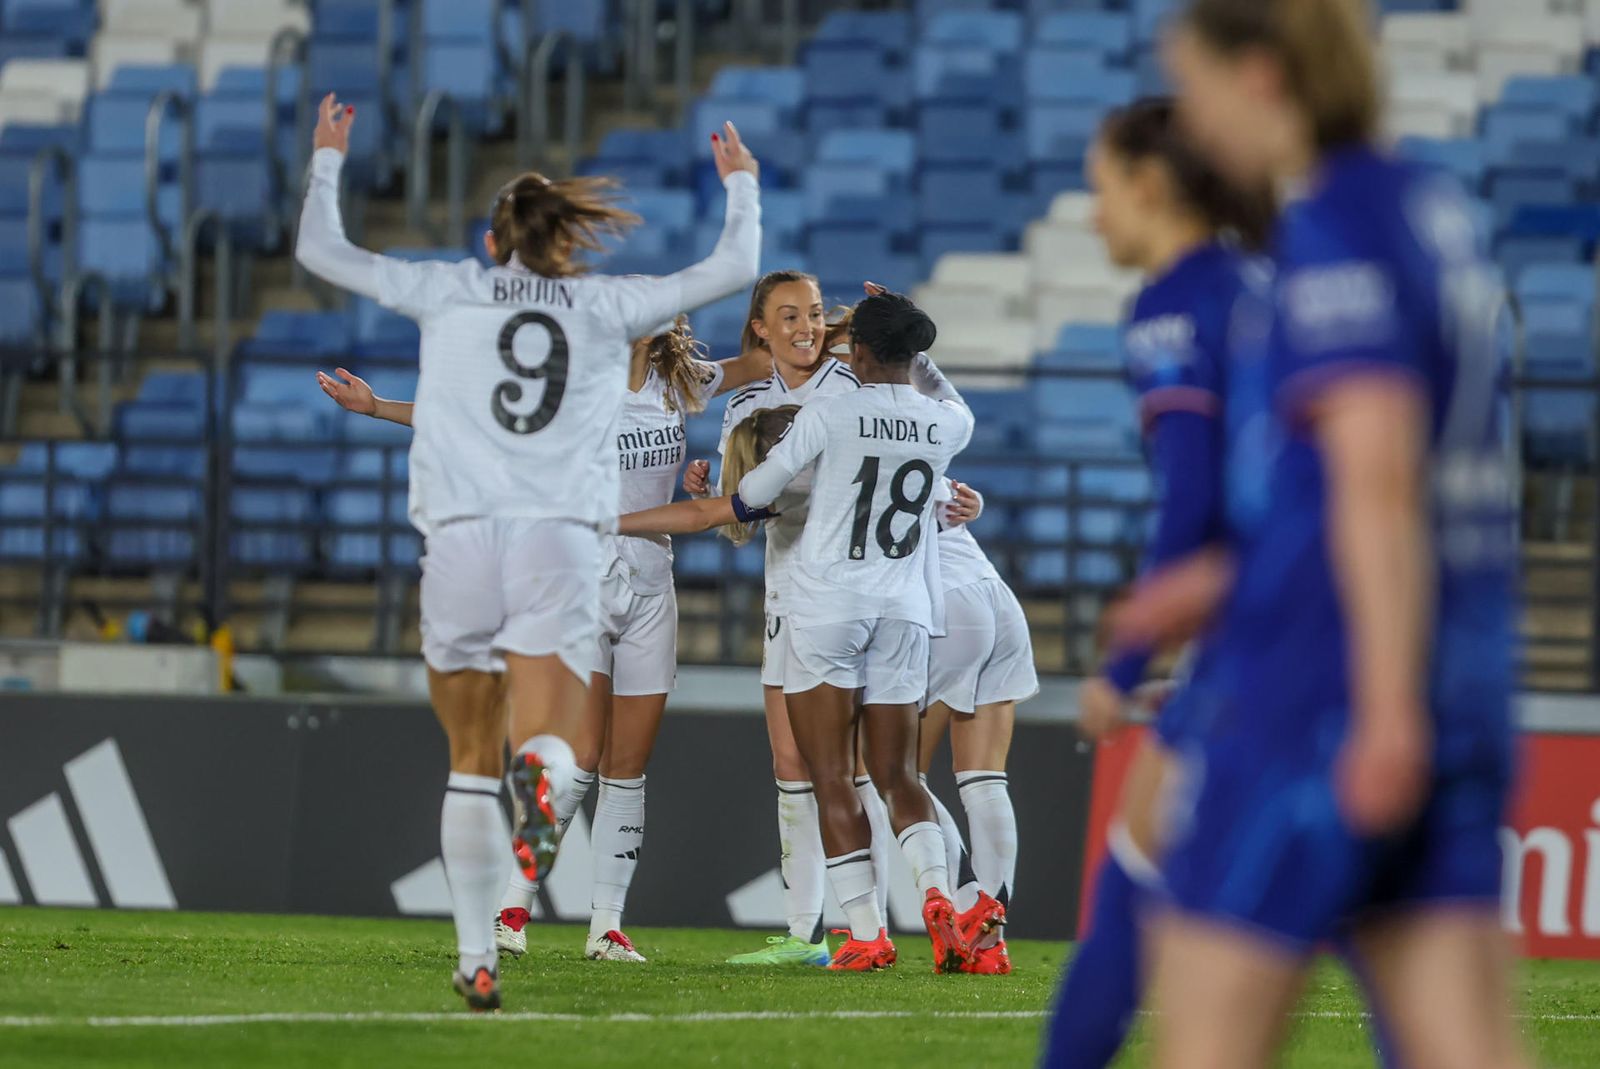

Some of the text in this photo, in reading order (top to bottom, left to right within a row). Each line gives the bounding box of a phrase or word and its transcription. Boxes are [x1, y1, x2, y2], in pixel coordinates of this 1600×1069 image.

[493, 276, 573, 309] BRUUN
[491, 310, 569, 435] 9
[617, 424, 686, 450] mirates
[859, 416, 942, 446] LINDA C.
[619, 446, 681, 471] FLY BETTER
[849, 455, 934, 560] 18
